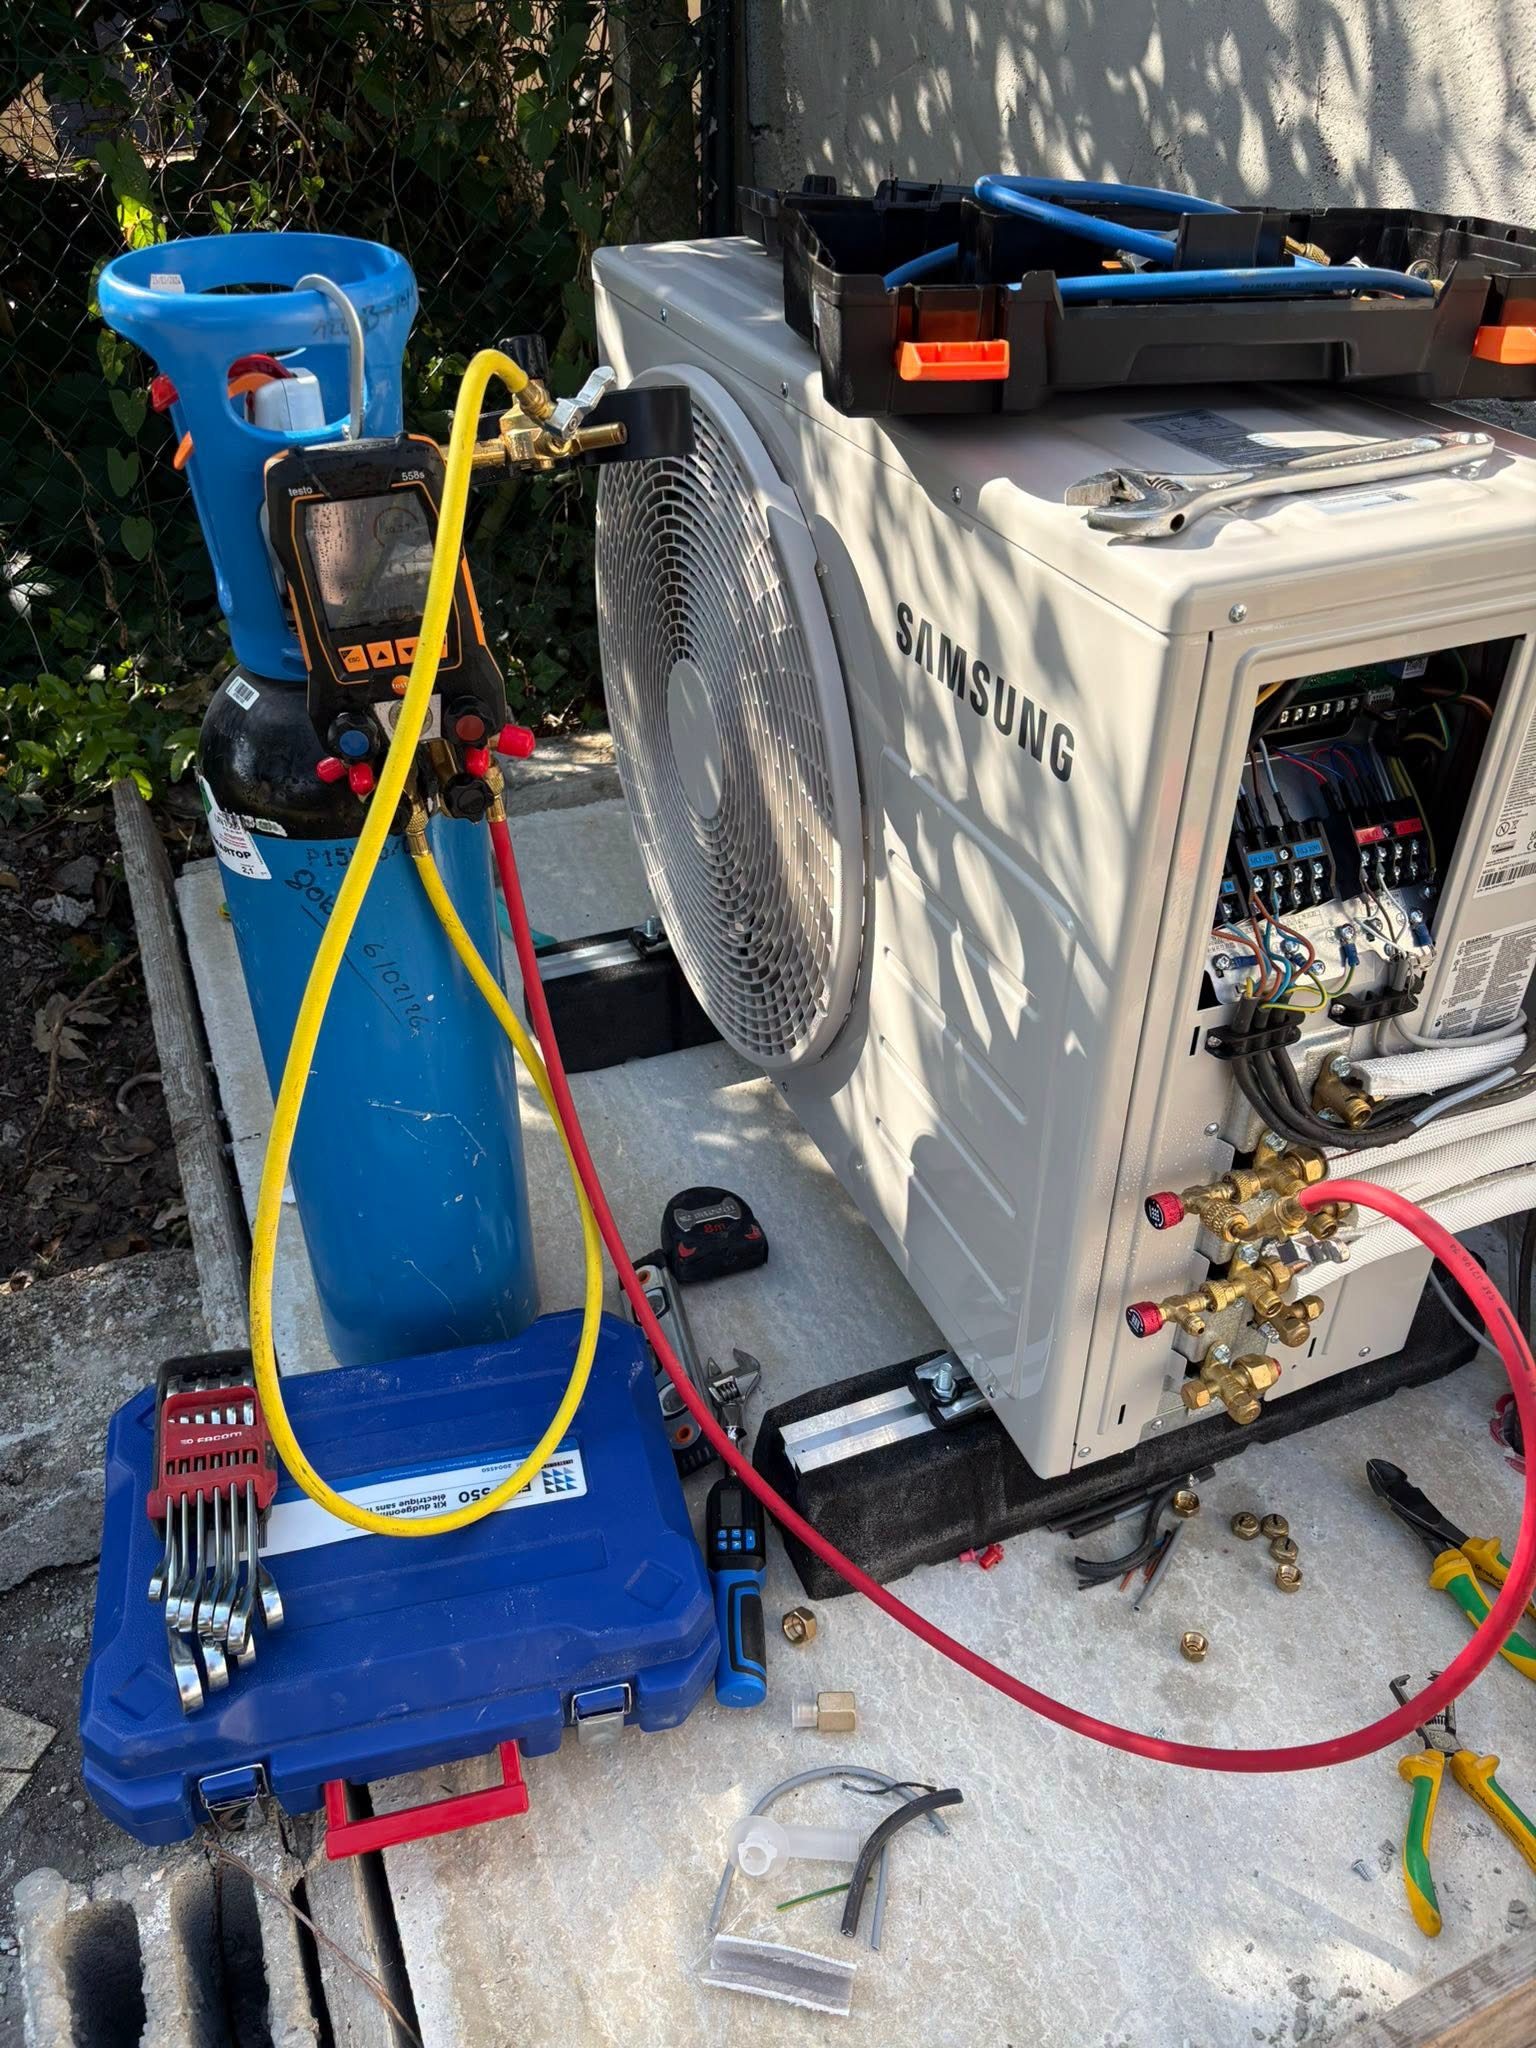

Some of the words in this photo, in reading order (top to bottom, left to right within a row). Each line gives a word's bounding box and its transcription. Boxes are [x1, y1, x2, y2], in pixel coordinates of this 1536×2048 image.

[401, 470, 425, 481] 558s
[288, 486, 313, 497] testo
[896, 602, 1075, 783] SAMSUNG
[1465, 934, 1492, 945] WARNING
[1442, 1007, 1467, 1019] CAUTION
[197, 1431, 242, 1443] FACOM
[398, 1493, 447, 1508] électrique
[433, 1500, 447, 1509] Kit
[375, 1502, 397, 1512] sans
